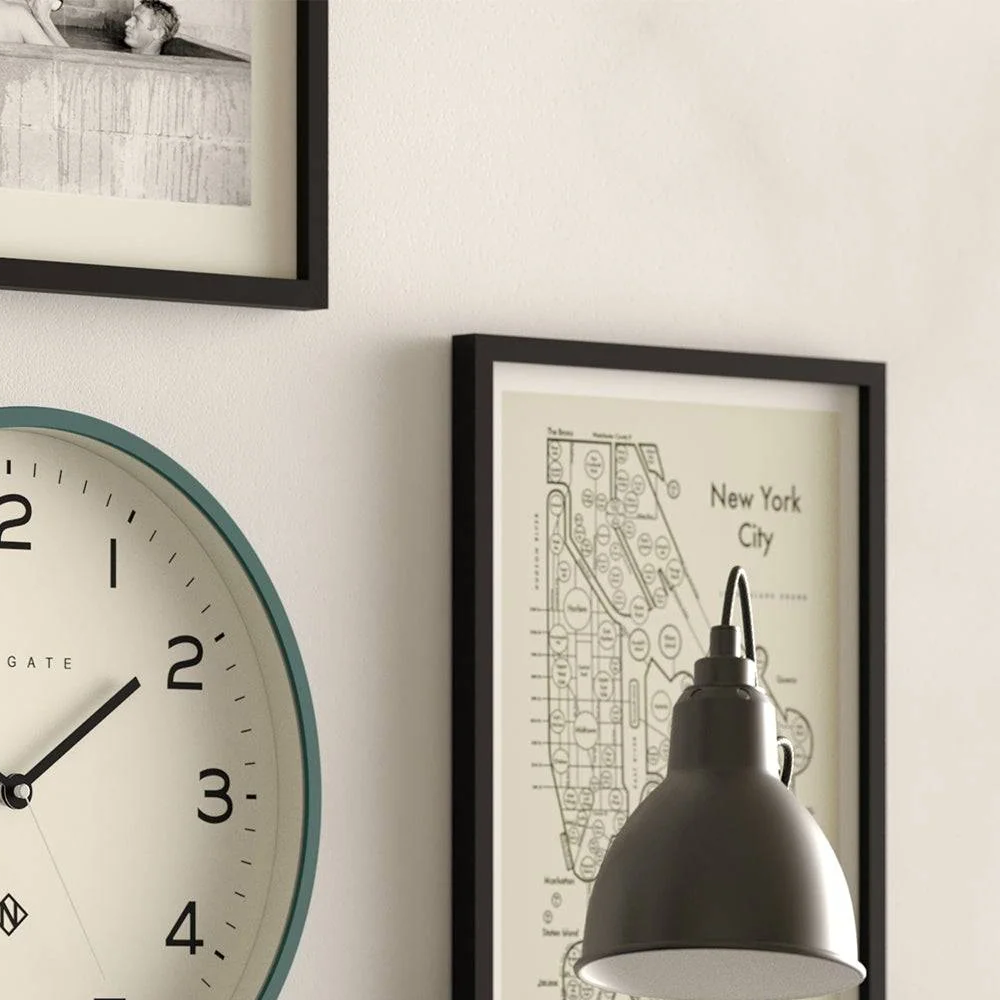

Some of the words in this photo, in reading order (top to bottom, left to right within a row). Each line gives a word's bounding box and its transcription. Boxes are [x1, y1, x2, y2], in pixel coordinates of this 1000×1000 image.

[710, 483, 754, 509] New
[760, 485, 802, 513] York
[738, 522, 774, 557] City
[166, 634, 204, 690] 2
[197, 767, 234, 825] 3
[165, 900, 205, 956] 4
